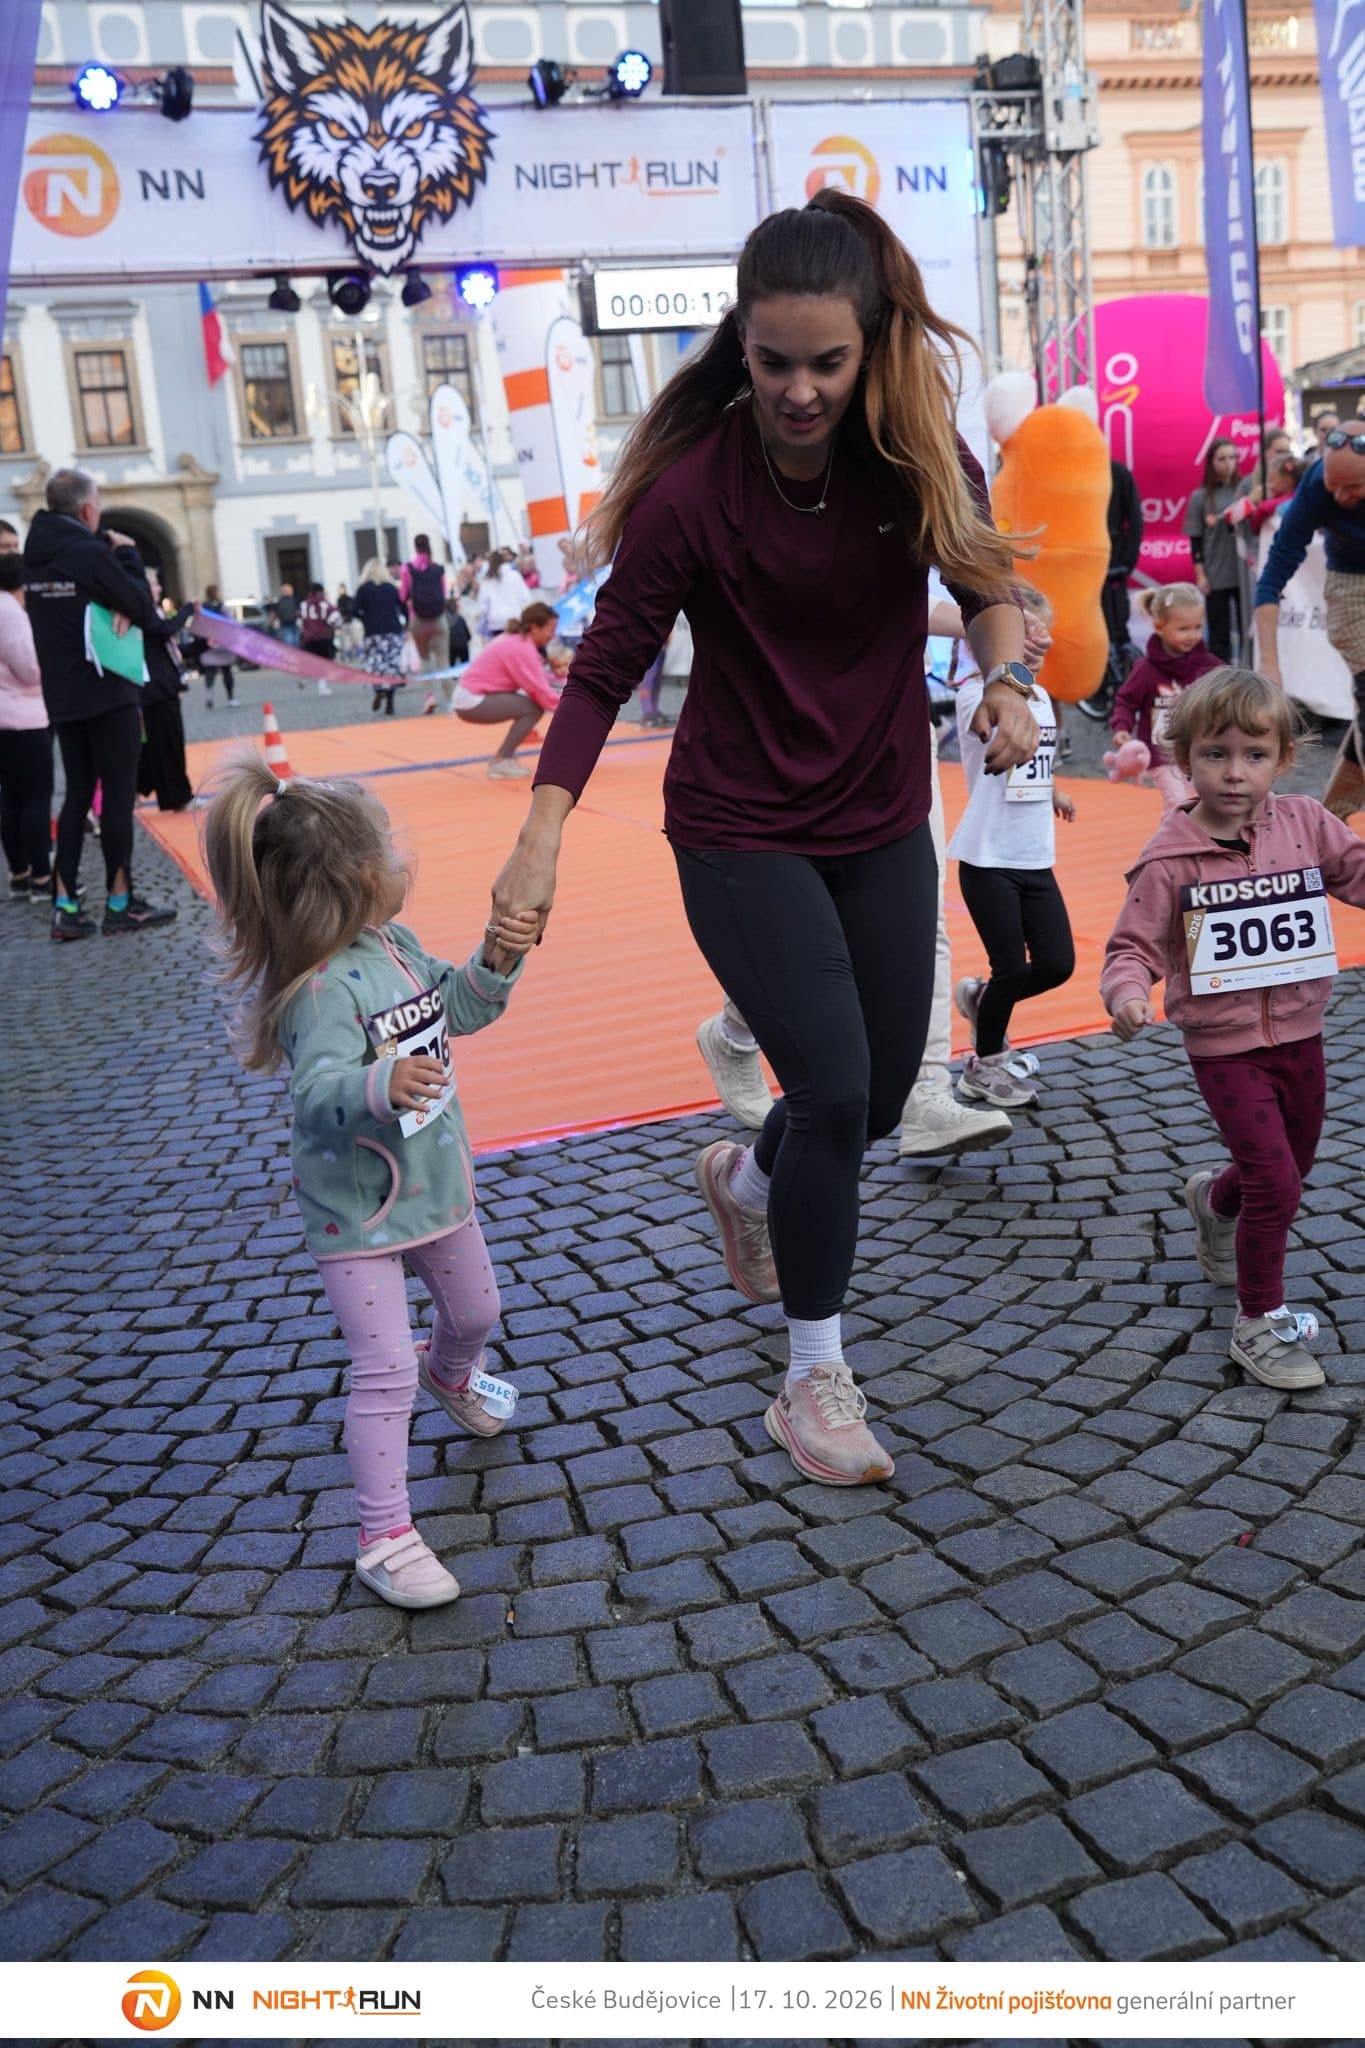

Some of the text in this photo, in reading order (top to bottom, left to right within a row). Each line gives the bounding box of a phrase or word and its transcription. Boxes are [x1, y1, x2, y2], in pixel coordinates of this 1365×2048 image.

[137, 169, 206, 200] NN
[515, 161, 719, 189] NIGHT RUN
[896, 165, 948, 192] NN
[1190, 873, 1301, 907] KIDSCUP
[1187, 913, 1203, 940] 2026
[1210, 910, 1316, 961] 3063
[479, 1380, 511, 1399] 3165
